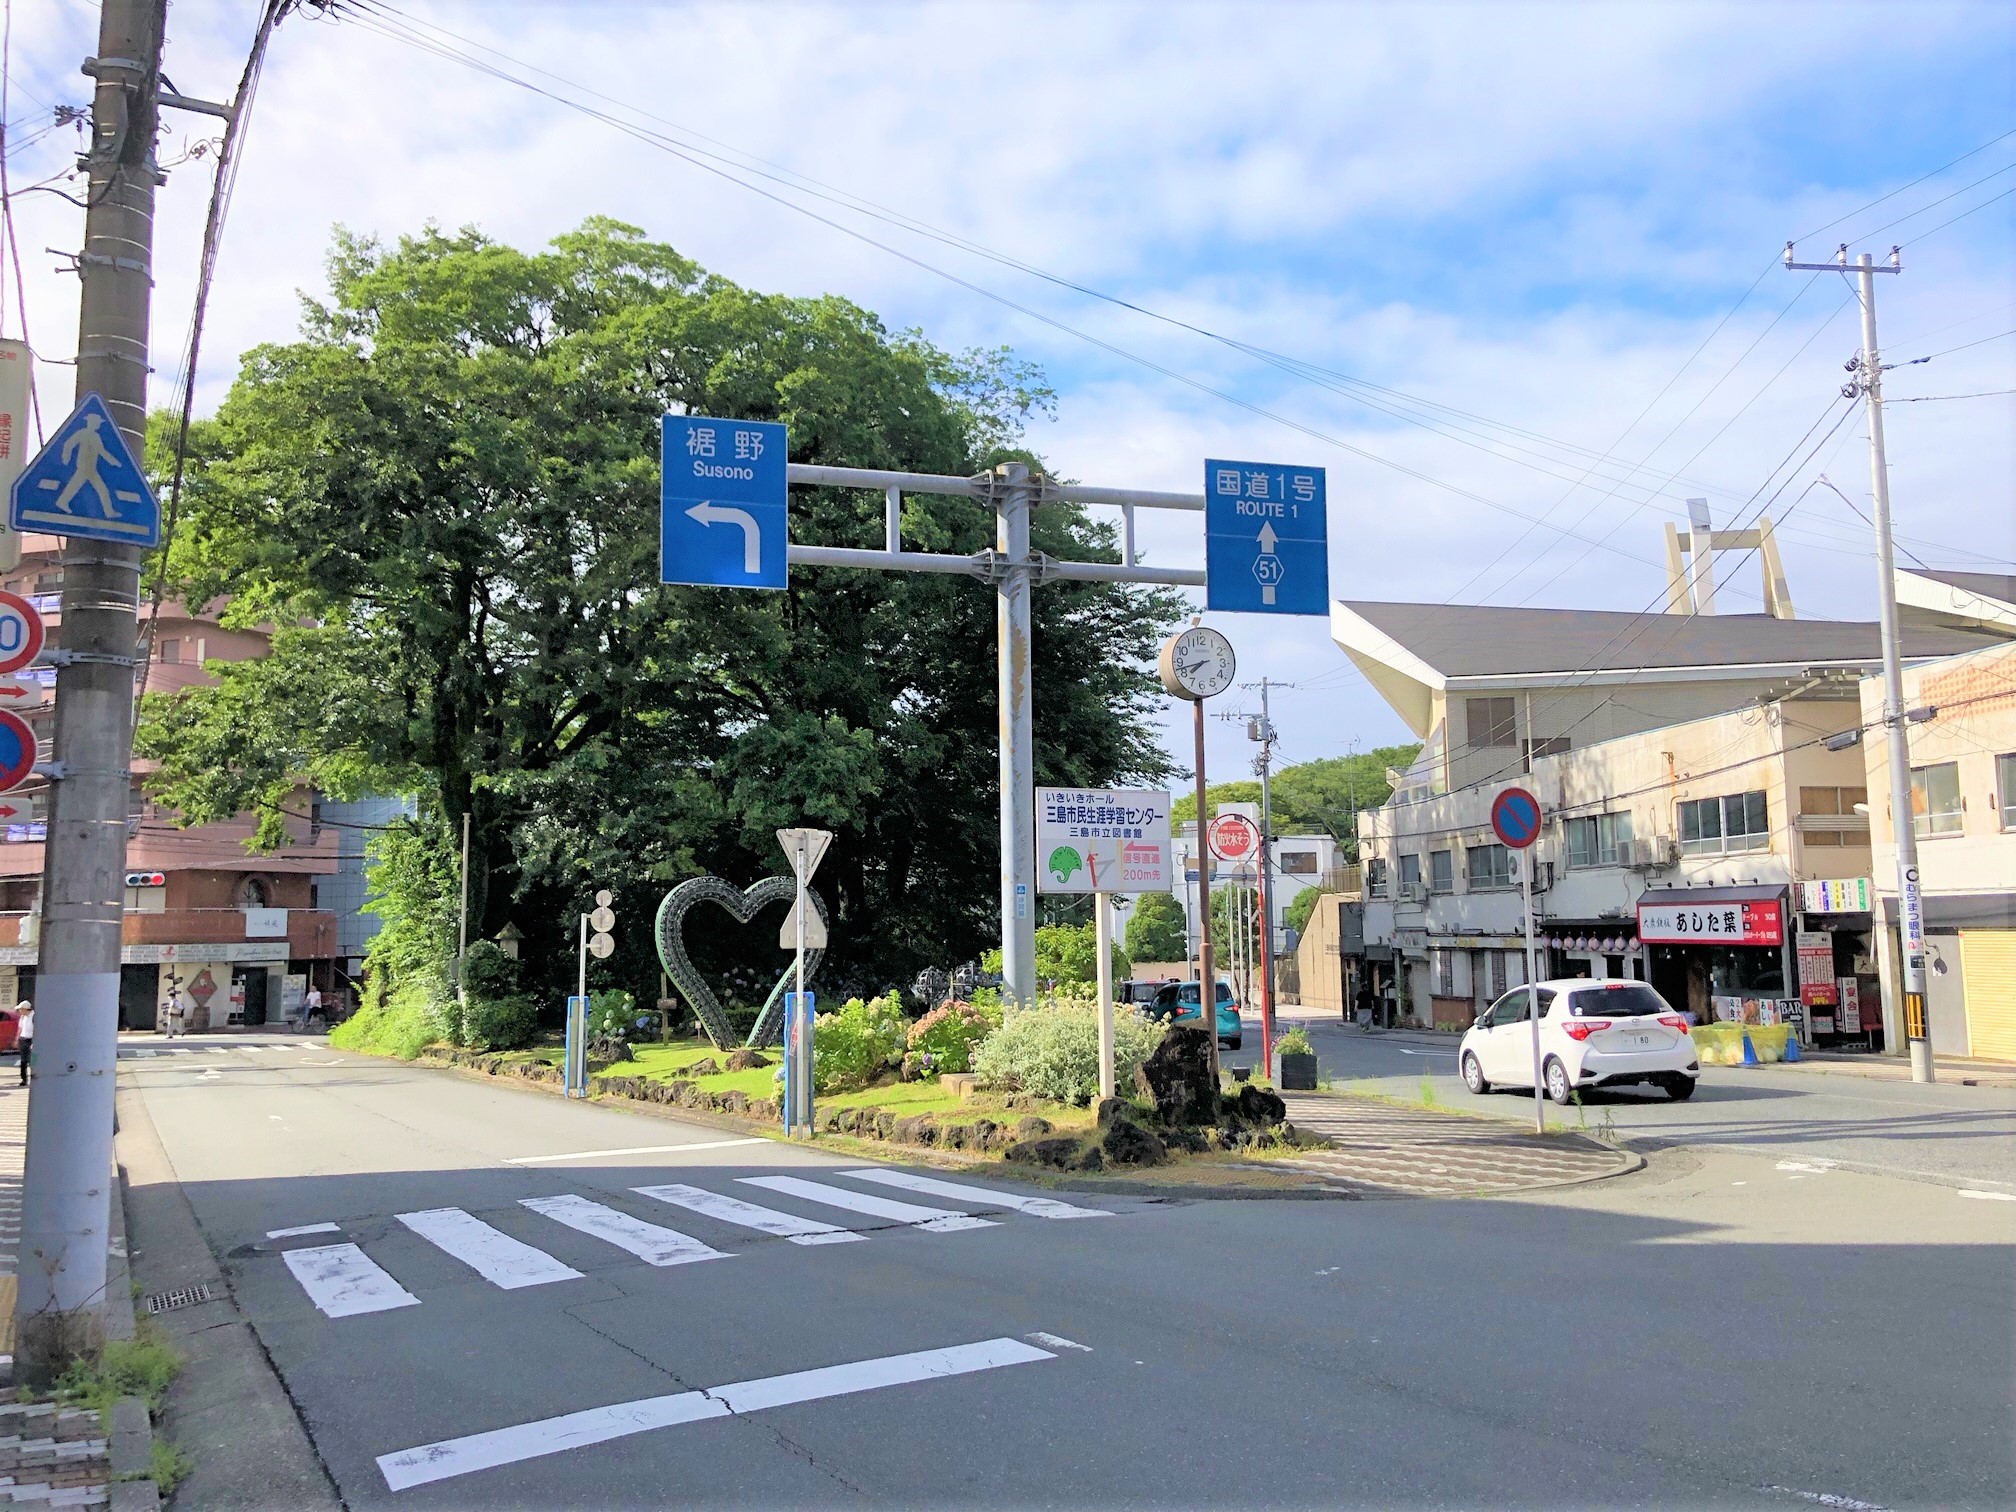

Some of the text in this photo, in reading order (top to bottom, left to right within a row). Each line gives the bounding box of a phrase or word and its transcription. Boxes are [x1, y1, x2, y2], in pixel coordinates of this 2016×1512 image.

[686, 427, 764, 460] 裾野
[693, 460, 753, 480] Susono
[1217, 469, 1316, 501] 国道1号
[1236, 500, 1298, 518] ROUTE 1
[1259, 560, 1277, 579] 51
[1188, 638, 1195, 647] 11
[1197, 636, 1206, 645] 12
[1178, 646, 1188, 656] 10
[1216, 647, 1223, 656] 2
[1177, 657, 1183, 667] 9
[1219, 658, 1226, 668] 3
[1181, 668, 1187, 678] 8
[1216, 669, 1223, 679] 4
[1189, 677, 1195, 687] 7
[1199, 681, 1205, 690] 6
[1209, 678, 1216, 687] 5
[1046, 792, 1114, 804] いきいきホール
[1046, 805, 1164, 825] 三島市民生涯学習センター
[1069, 827, 1142, 838] 三島市立図書館
[1217, 832, 1249, 846] 防火水そう
[1123, 853, 1160, 864] 信号直進
[1123, 869, 1160, 880] 200m先
[1905, 883, 1921, 940] むらまつ眼科
[1676, 911, 1737, 933] あした葉
[1780, 1002, 1802, 1015] BAR
